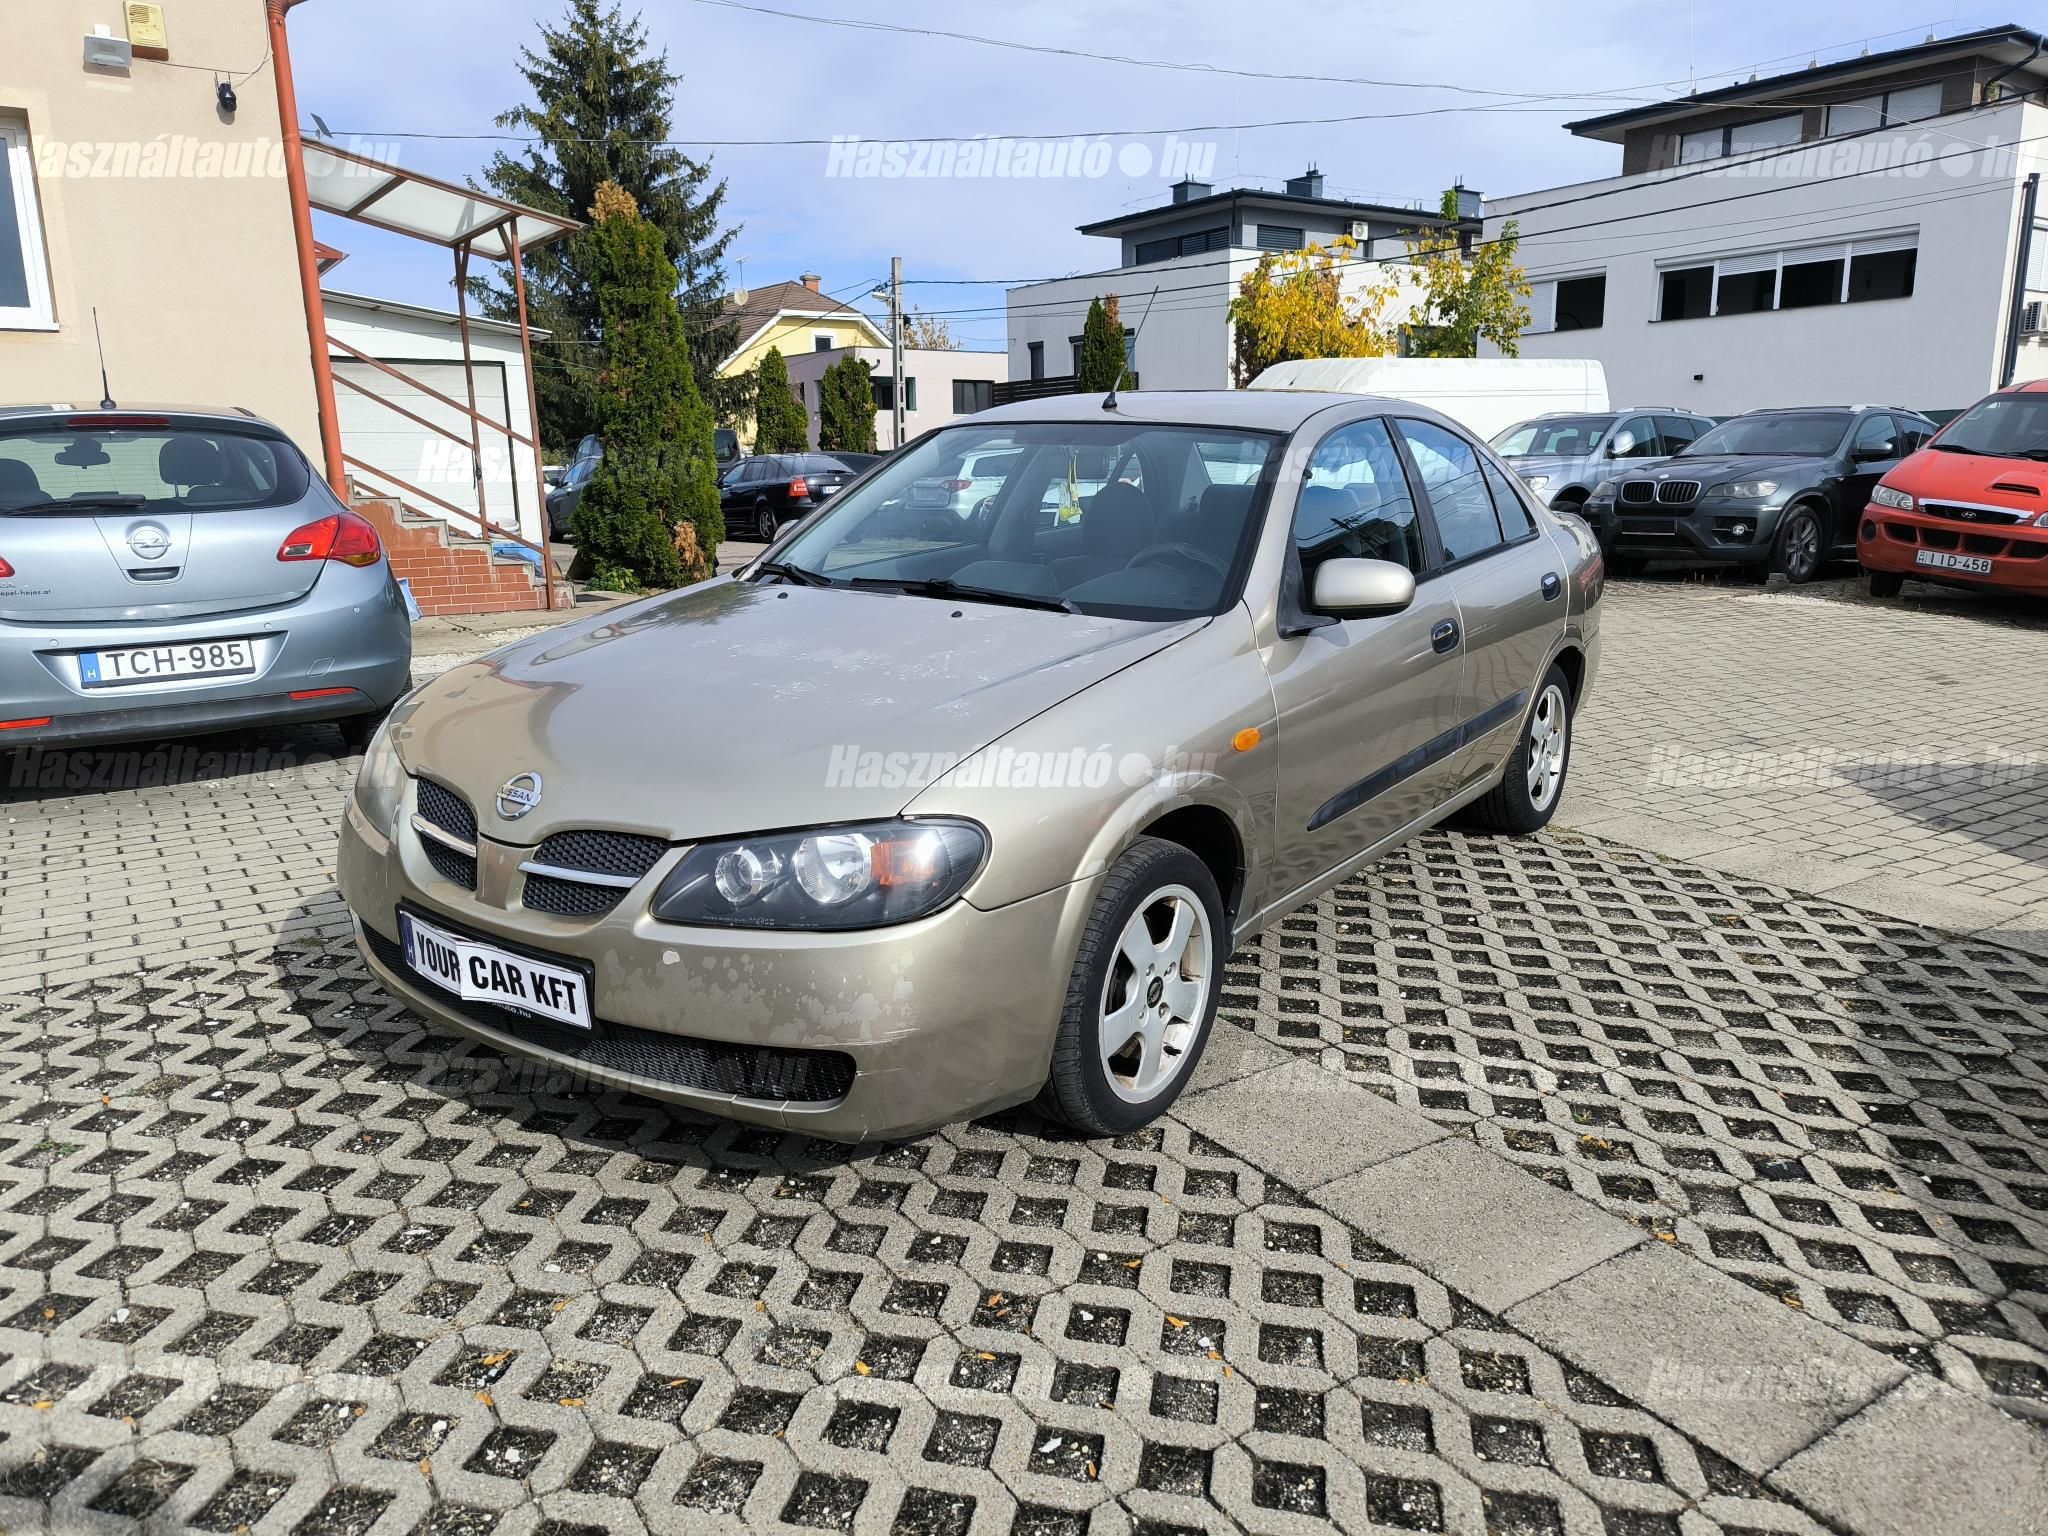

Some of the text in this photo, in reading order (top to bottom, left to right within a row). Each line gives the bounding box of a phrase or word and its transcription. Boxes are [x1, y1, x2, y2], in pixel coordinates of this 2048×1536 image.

[1931, 553, 1989, 572] IID-458
[105, 643, 244, 677] TCH-985
[499, 785, 534, 802] NISSAN
[416, 931, 461, 985] YOUR
[468, 955, 527, 999] CAR
[530, 971, 577, 1016] KFT
